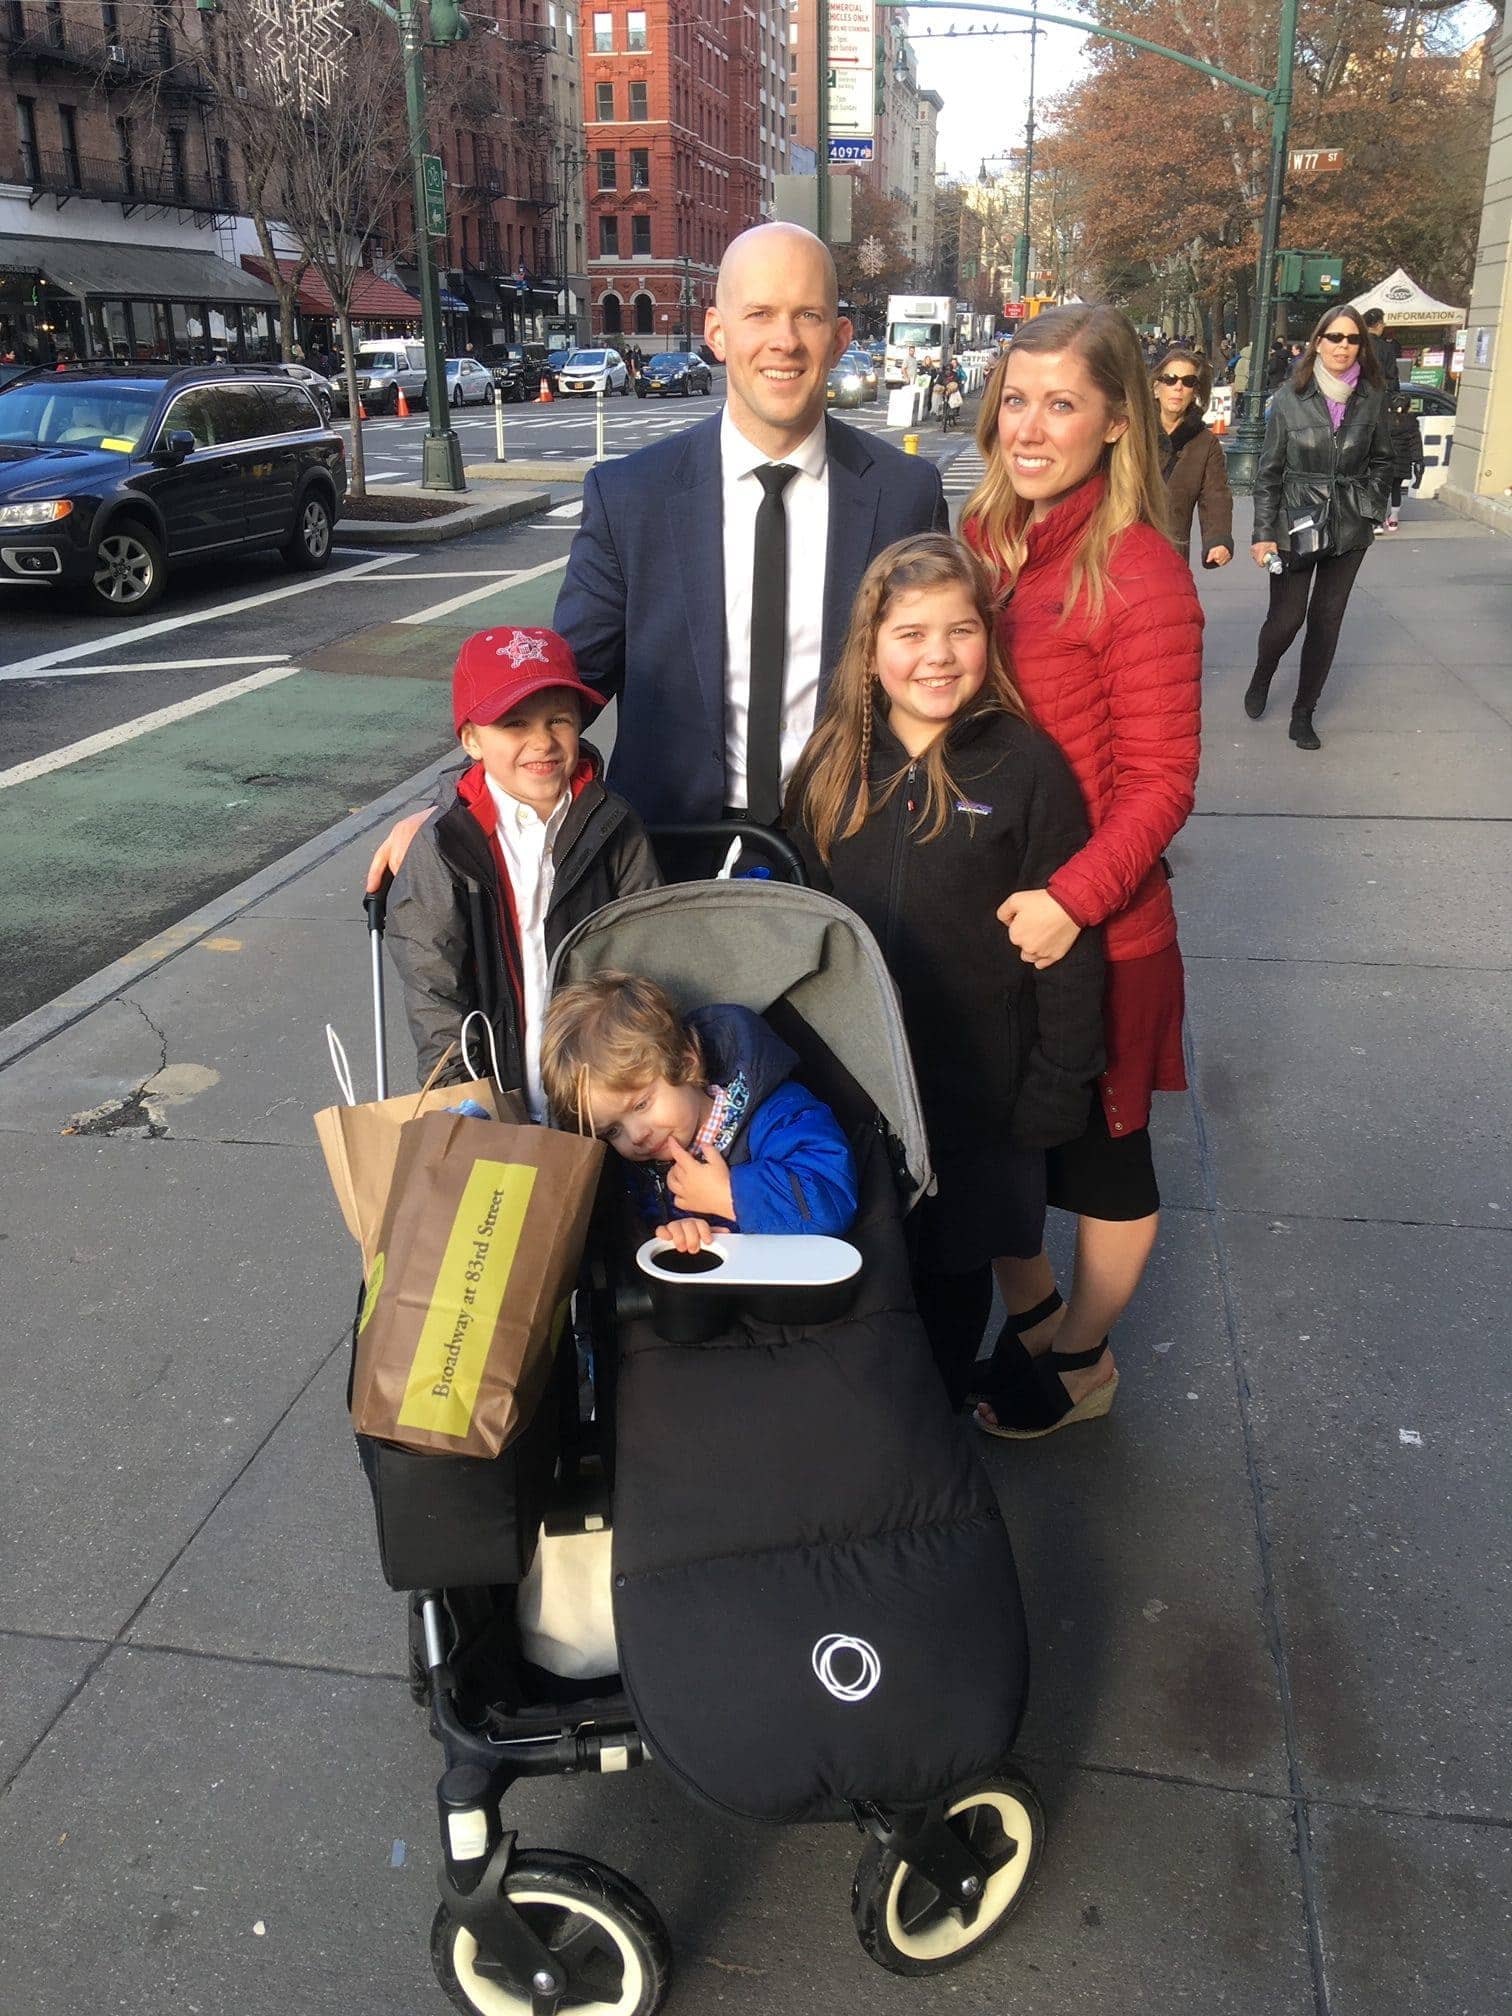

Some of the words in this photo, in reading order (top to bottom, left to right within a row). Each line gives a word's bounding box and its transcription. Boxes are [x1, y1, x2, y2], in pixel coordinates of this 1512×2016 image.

[853, 14, 869, 22] ONLY
[1327, 152, 1338, 162] ST
[1387, 311, 1455, 321] INFORMATION
[477, 1188, 504, 1237] Street
[464, 1240, 490, 1282] 83rd
[463, 1286, 477, 1305] at
[432, 1307, 474, 1400] Broadway
